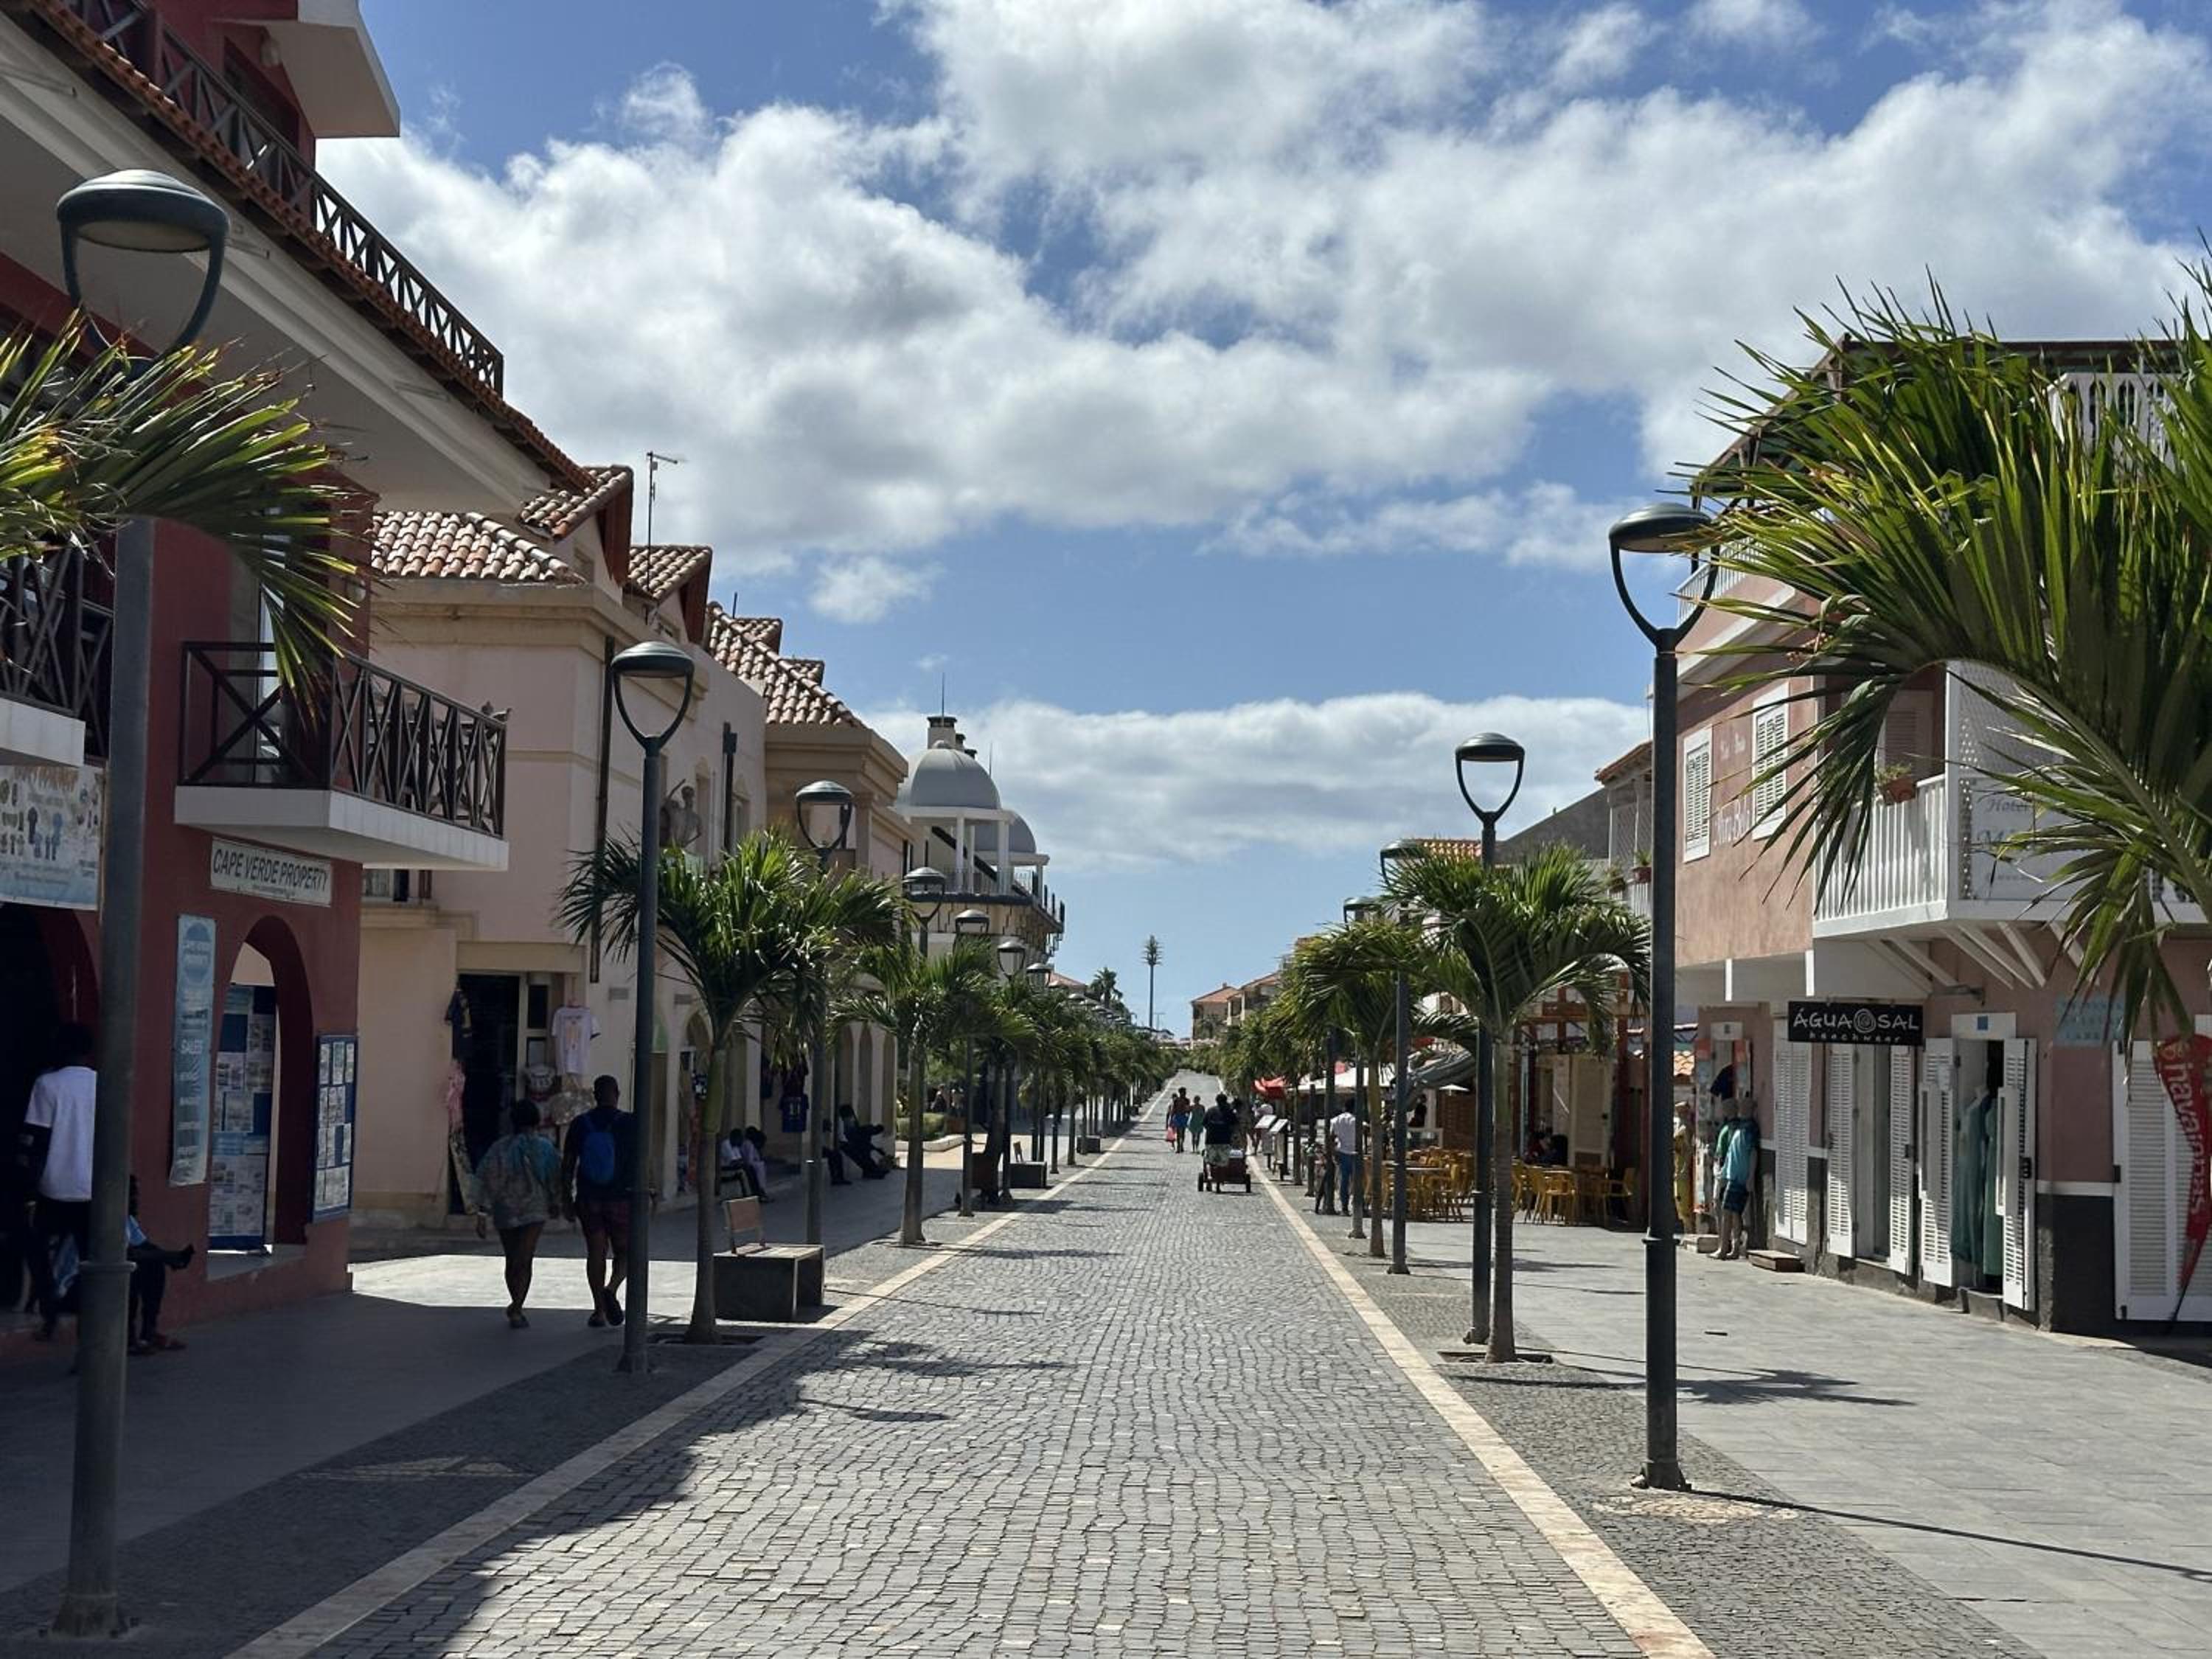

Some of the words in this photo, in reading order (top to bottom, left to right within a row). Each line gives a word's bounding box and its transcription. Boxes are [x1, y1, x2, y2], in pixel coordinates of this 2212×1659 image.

[213, 849, 244, 877] CAPE
[246, 855, 279, 884] VERDE
[280, 862, 328, 891] PROPERTY
[1793, 1007, 1853, 1029] ÁGUA
[1877, 1014, 1919, 1030] SAL
